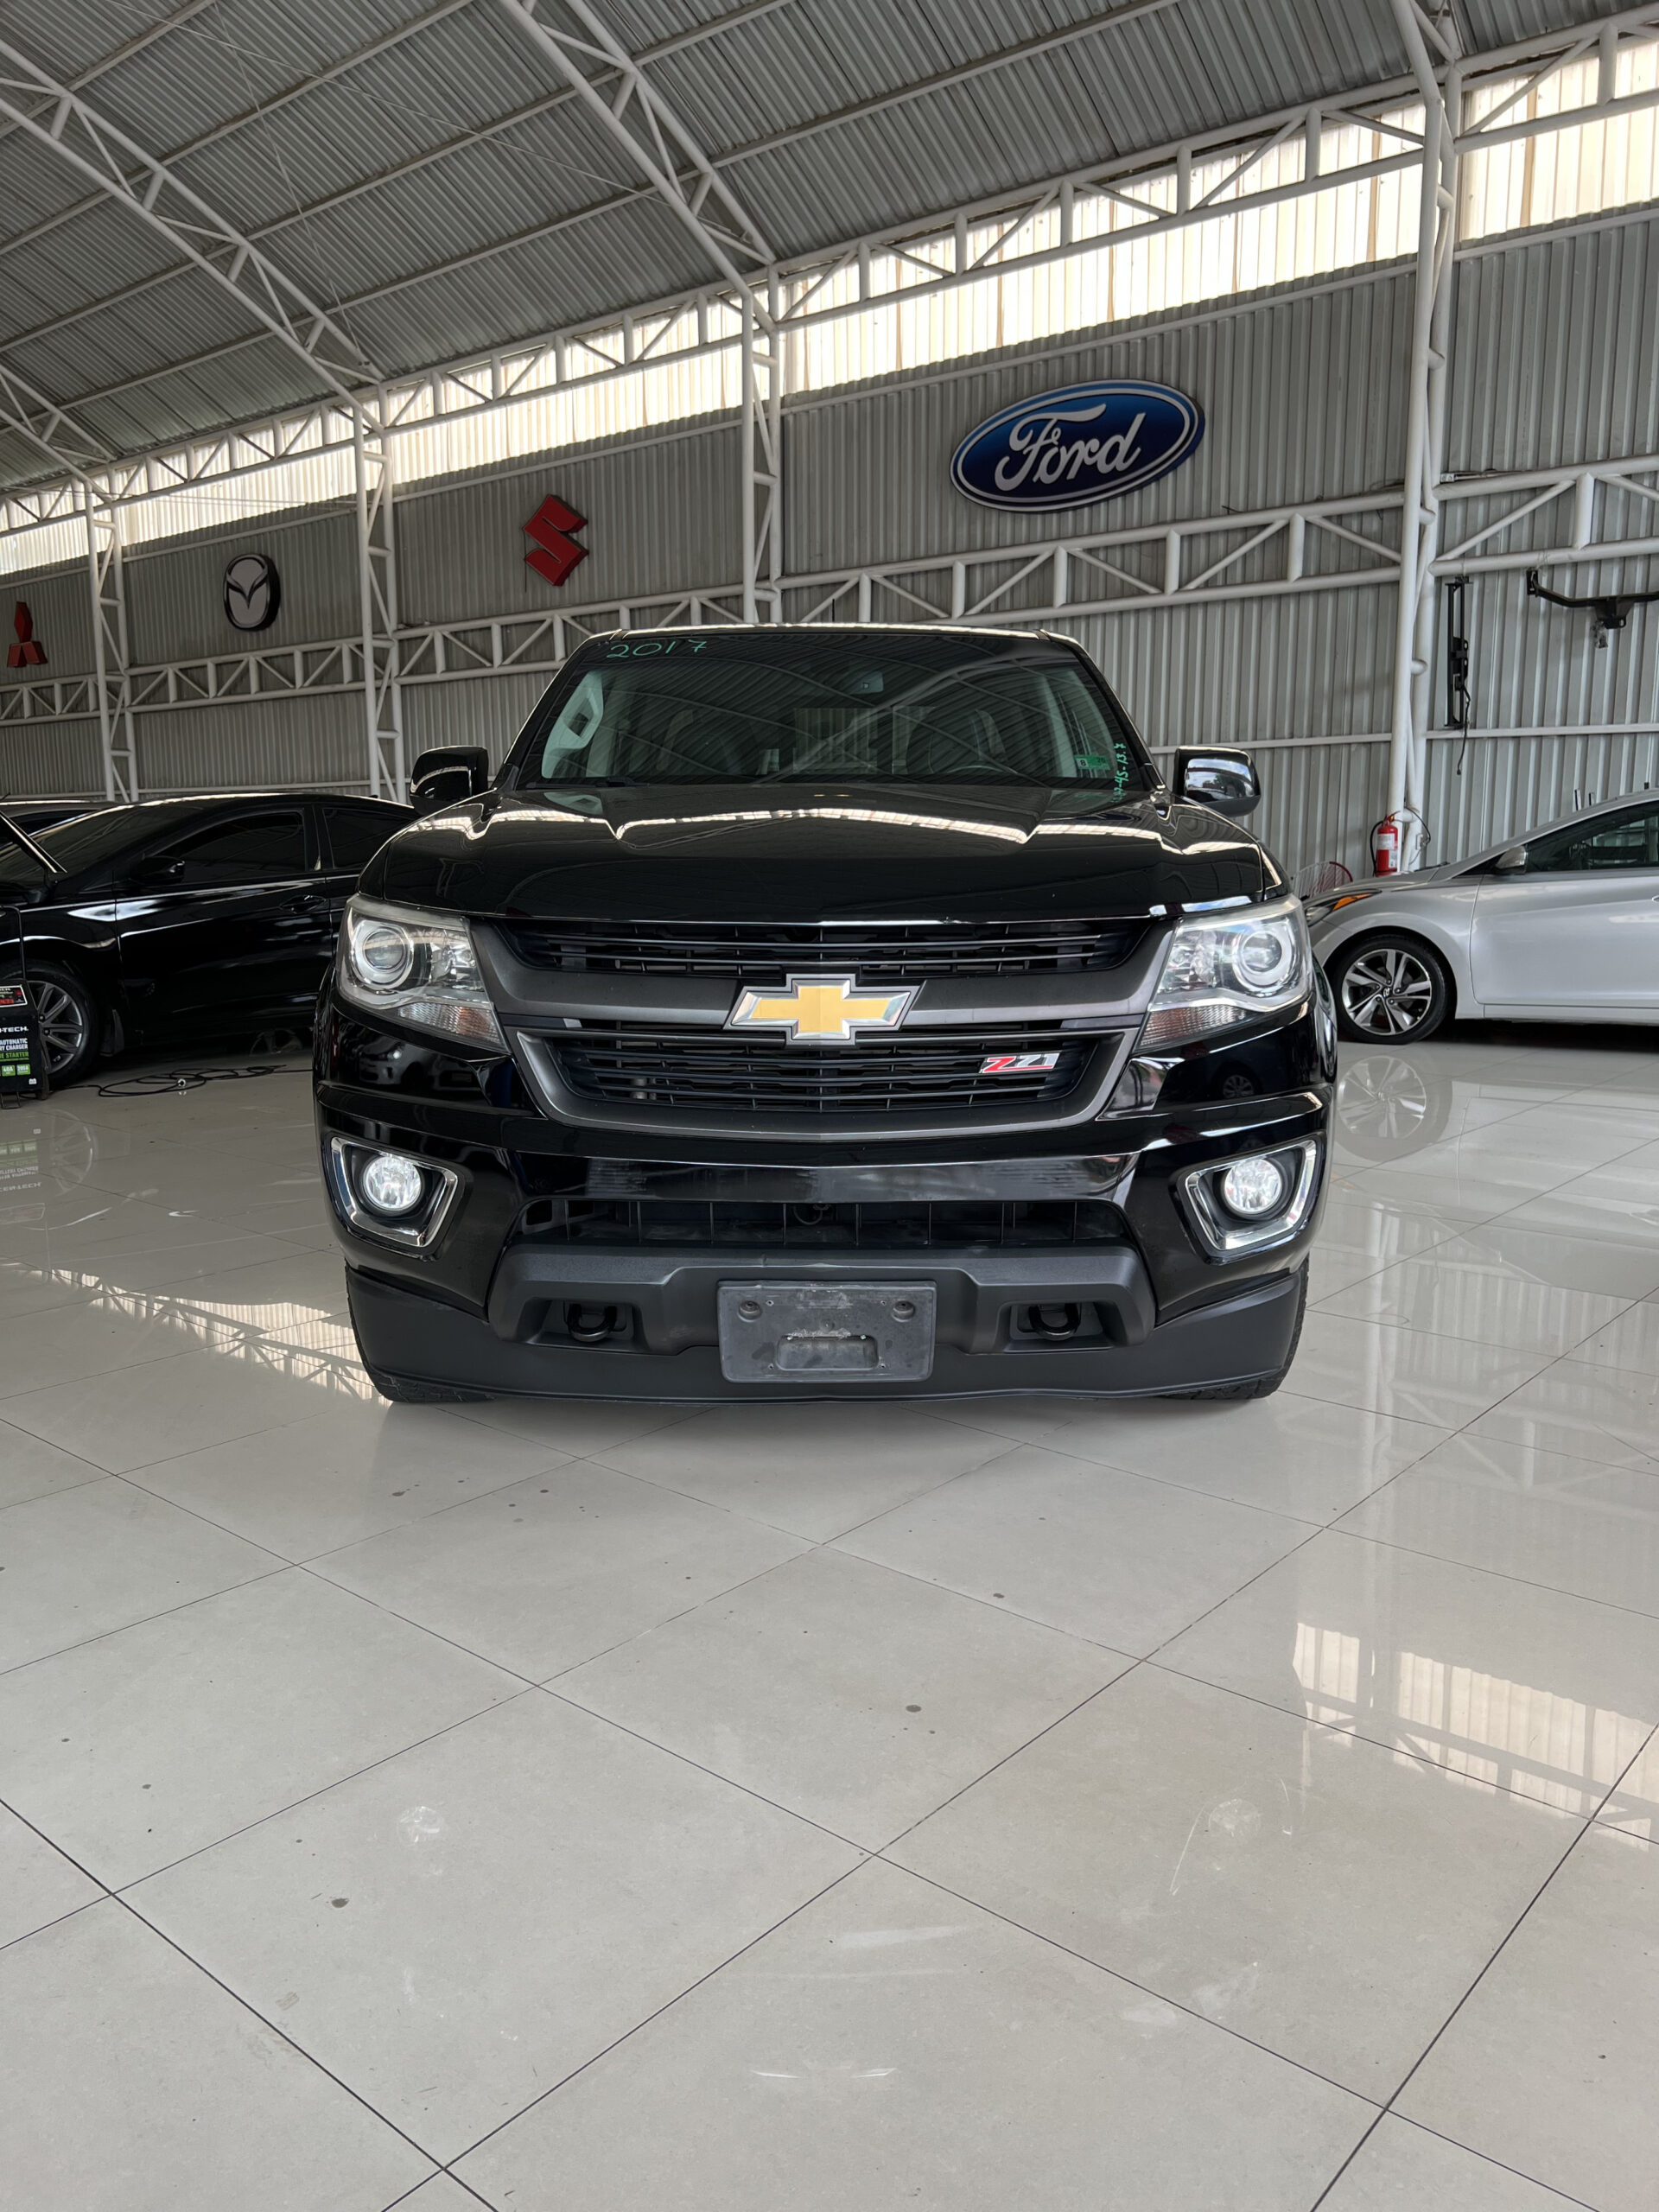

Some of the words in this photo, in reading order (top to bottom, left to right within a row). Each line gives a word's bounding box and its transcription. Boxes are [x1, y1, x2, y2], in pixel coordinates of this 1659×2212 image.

[994, 403, 1147, 492] Ford
[606, 639, 708, 658] 2017
[981, 1052, 1061, 1074] Z71
